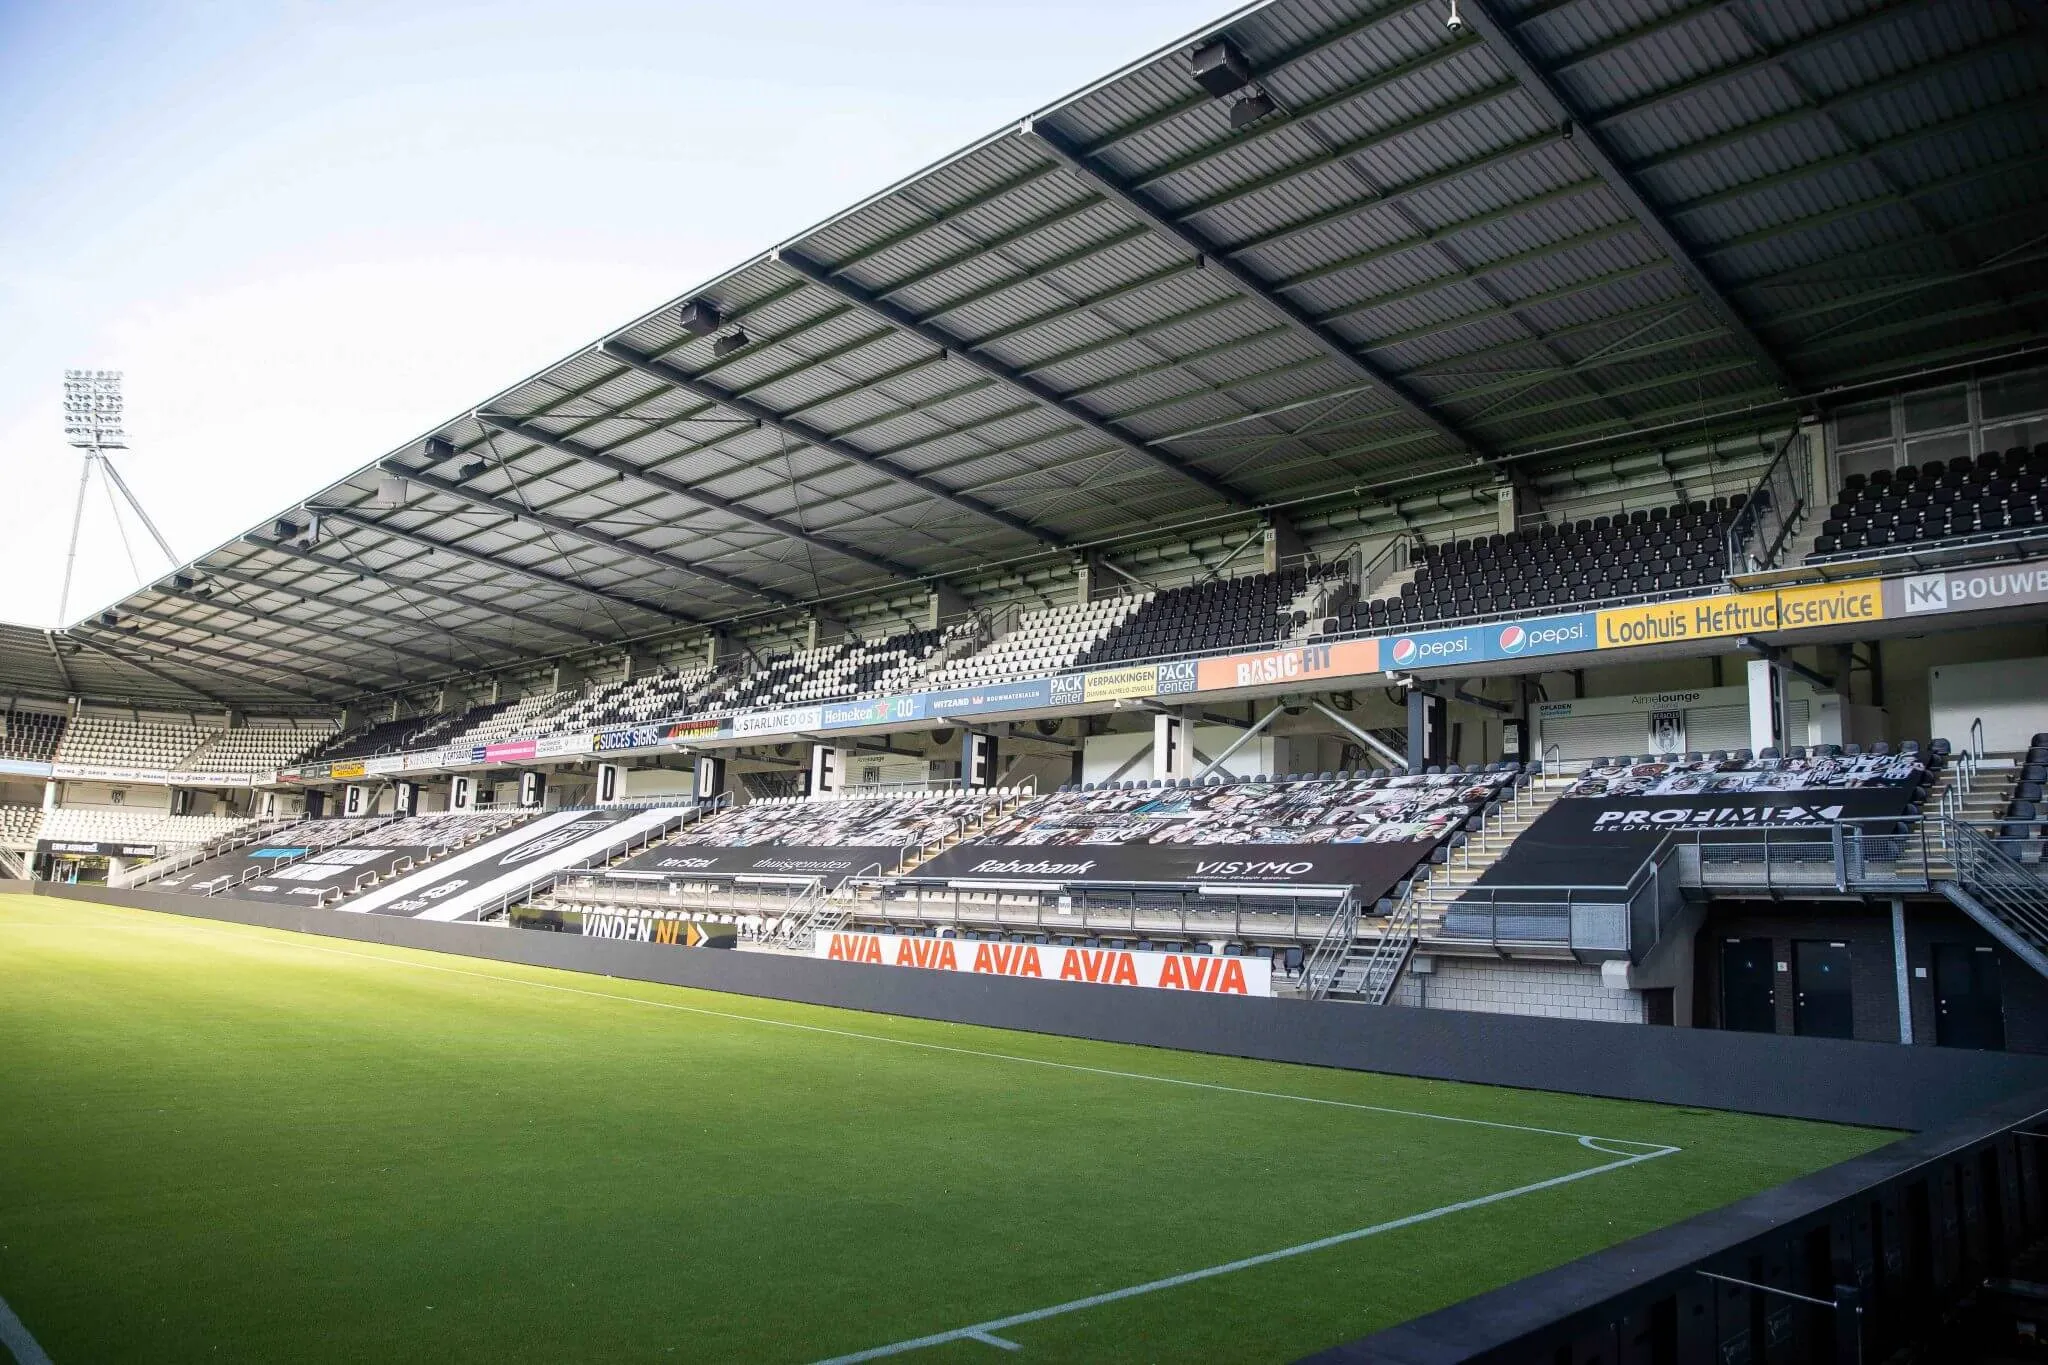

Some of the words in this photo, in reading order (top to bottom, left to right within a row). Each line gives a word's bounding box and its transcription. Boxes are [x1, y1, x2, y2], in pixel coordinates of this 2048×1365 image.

[1910, 580, 1943, 605] NK
[1607, 611, 1686, 643] Loohuis
[1696, 590, 1872, 633] Heftruckservice
[1087, 670, 1154, 687] VERPAKKINGEN
[1158, 663, 1195, 681] PACK
[1237, 646, 1331, 686] BASIC-FIT
[1050, 674, 1082, 693] PACK
[1158, 679, 1195, 695] center
[934, 697, 970, 709] WITZAND
[987, 690, 1040, 702] BOUWMATERIALEN
[1050, 690, 1082, 705] center
[825, 708, 873, 724] Heineken
[1423, 695, 1435, 759] F
[600, 732, 631, 749] SUCCES
[632, 728, 658, 746] SIGNS
[1166, 718, 1180, 772] F
[820, 748, 834, 791] E
[970, 735, 987, 785] E
[522, 772, 536, 806] C
[602, 766, 615, 801] D
[699, 758, 714, 797] D
[266, 794, 274, 816] A
[348, 787, 360, 812] B
[398, 783, 410, 811] B
[455, 778, 468, 808] C
[752, 858, 852, 871] thuisgenoten
[968, 860, 1097, 874] Rabobank
[1195, 861, 1313, 874] VISYMO
[582, 913, 653, 942] VINDEN
[828, 934, 883, 963] AVIA
[896, 938, 957, 971] AVIA
[974, 943, 1043, 977] AVIA
[1060, 949, 1138, 985] AVIA
[1158, 955, 1248, 994] AVIA
